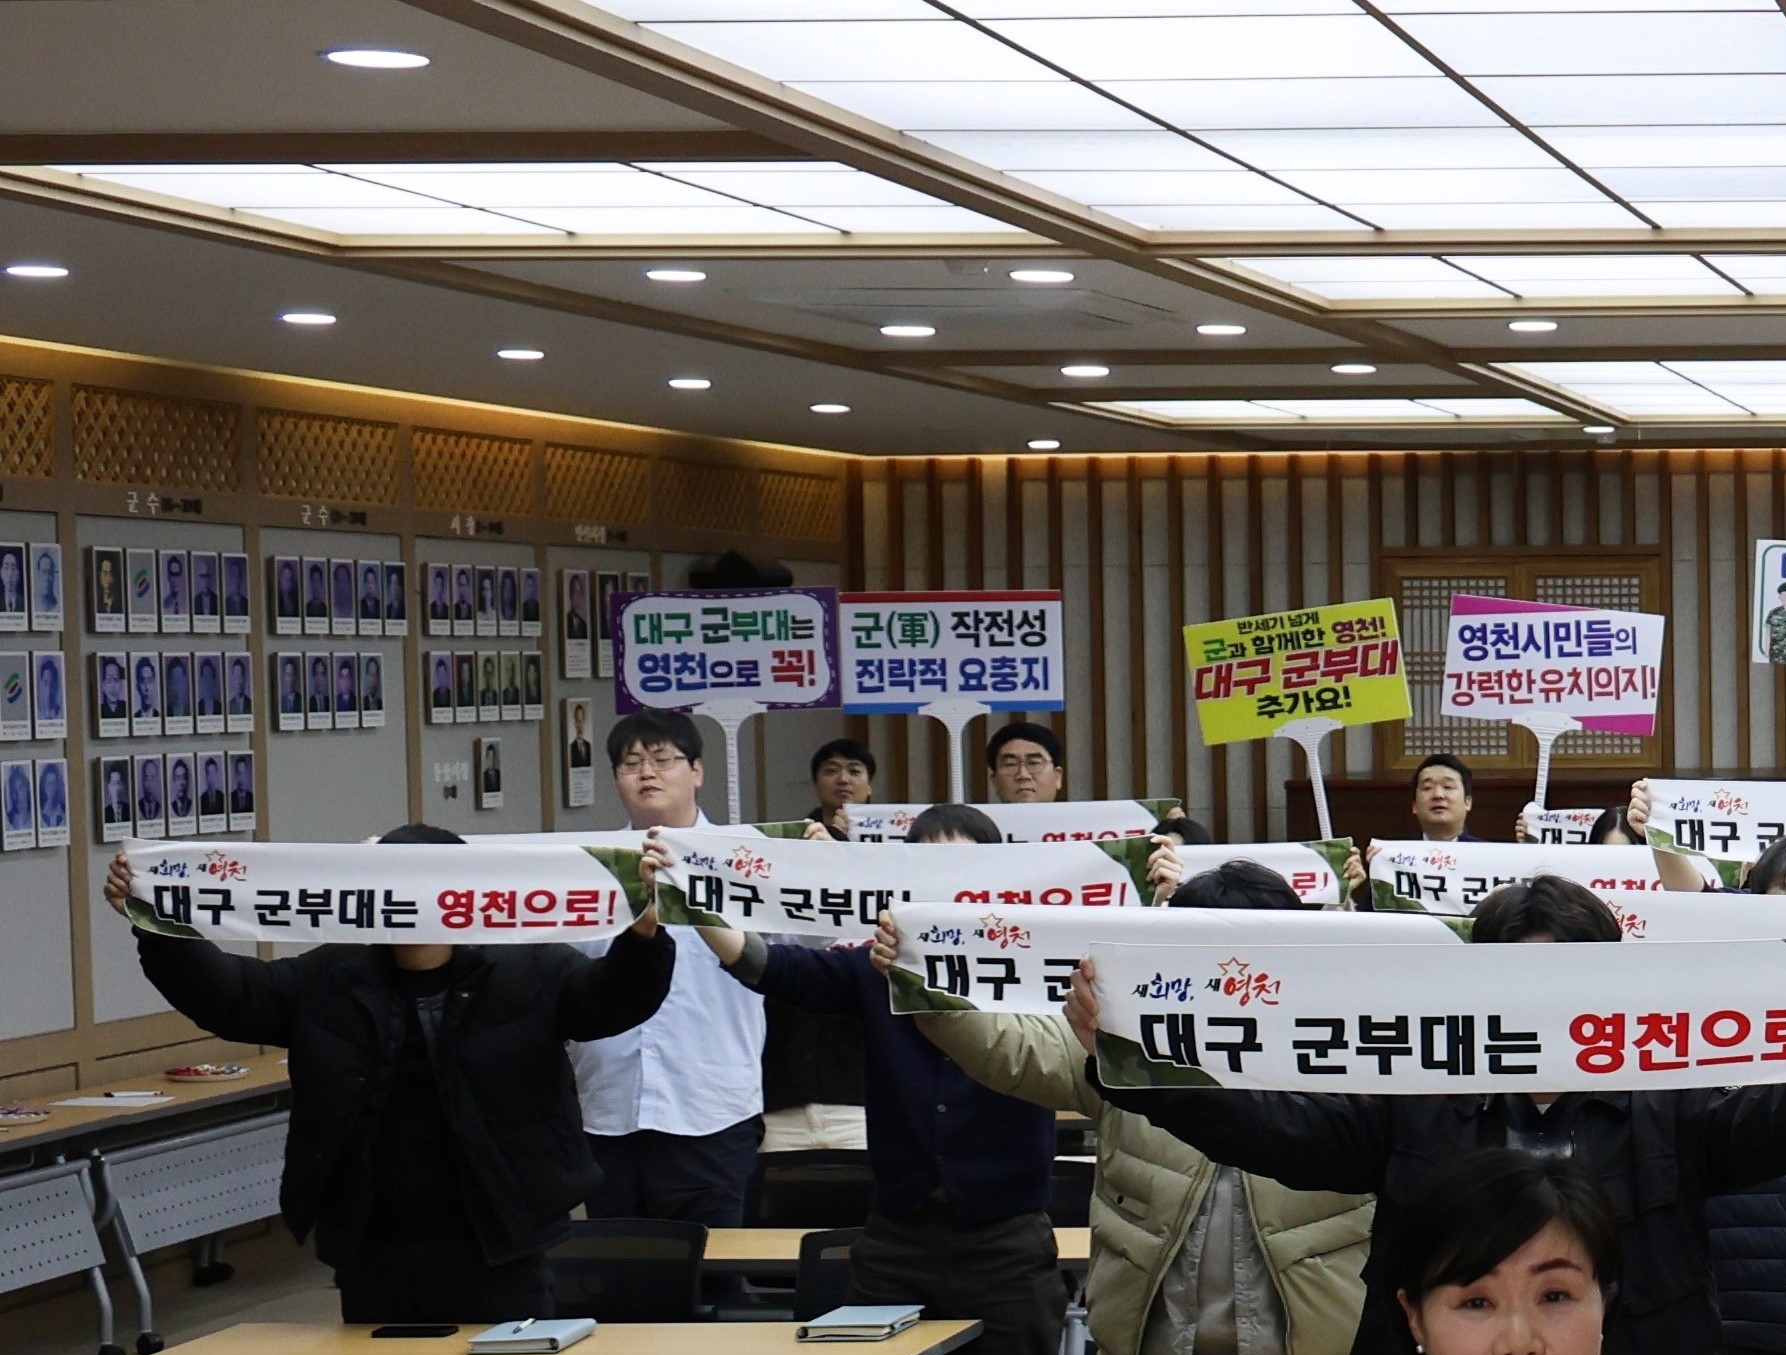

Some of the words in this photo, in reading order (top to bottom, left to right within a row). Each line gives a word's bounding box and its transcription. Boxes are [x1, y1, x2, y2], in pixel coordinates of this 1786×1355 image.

[634, 613, 693, 645] 대구
[701, 607, 816, 642] 군부대는
[851, 611, 940, 649] 군(軍)
[951, 610, 1047, 647] 작전성
[1203, 638, 1247, 662] 군과
[1251, 628, 1326, 655] 함께한
[1331, 616, 1386, 644] 영천!
[1237, 617, 1284, 635] 반세기
[1458, 619, 1637, 662] 영천시민들의
[638, 652, 761, 693] 영천으로
[771, 650, 816, 688] 꼭!
[856, 657, 947, 693] 전략적
[958, 656, 1049, 692] 요충지
[1194, 657, 1271, 700] 대구
[1281, 639, 1399, 690] 군부대
[1446, 669, 1534, 706] 강력한
[1538, 664, 1657, 702] 유치의지!
[1256, 686, 1352, 719] 추가요!
[1674, 820, 1741, 851] 대구
[688, 875, 765, 917] 대구
[779, 887, 910, 927] 군부대
[1395, 870, 1448, 901] 대구
[154, 885, 236, 925] 대구
[256, 888, 419, 928] 군부대는
[437, 889, 615, 929] 영천으로!
[924, 954, 1022, 1002] 대구
[1140, 1013, 1262, 1073] 대구
[1291, 1014, 1543, 1076] 군부대는
